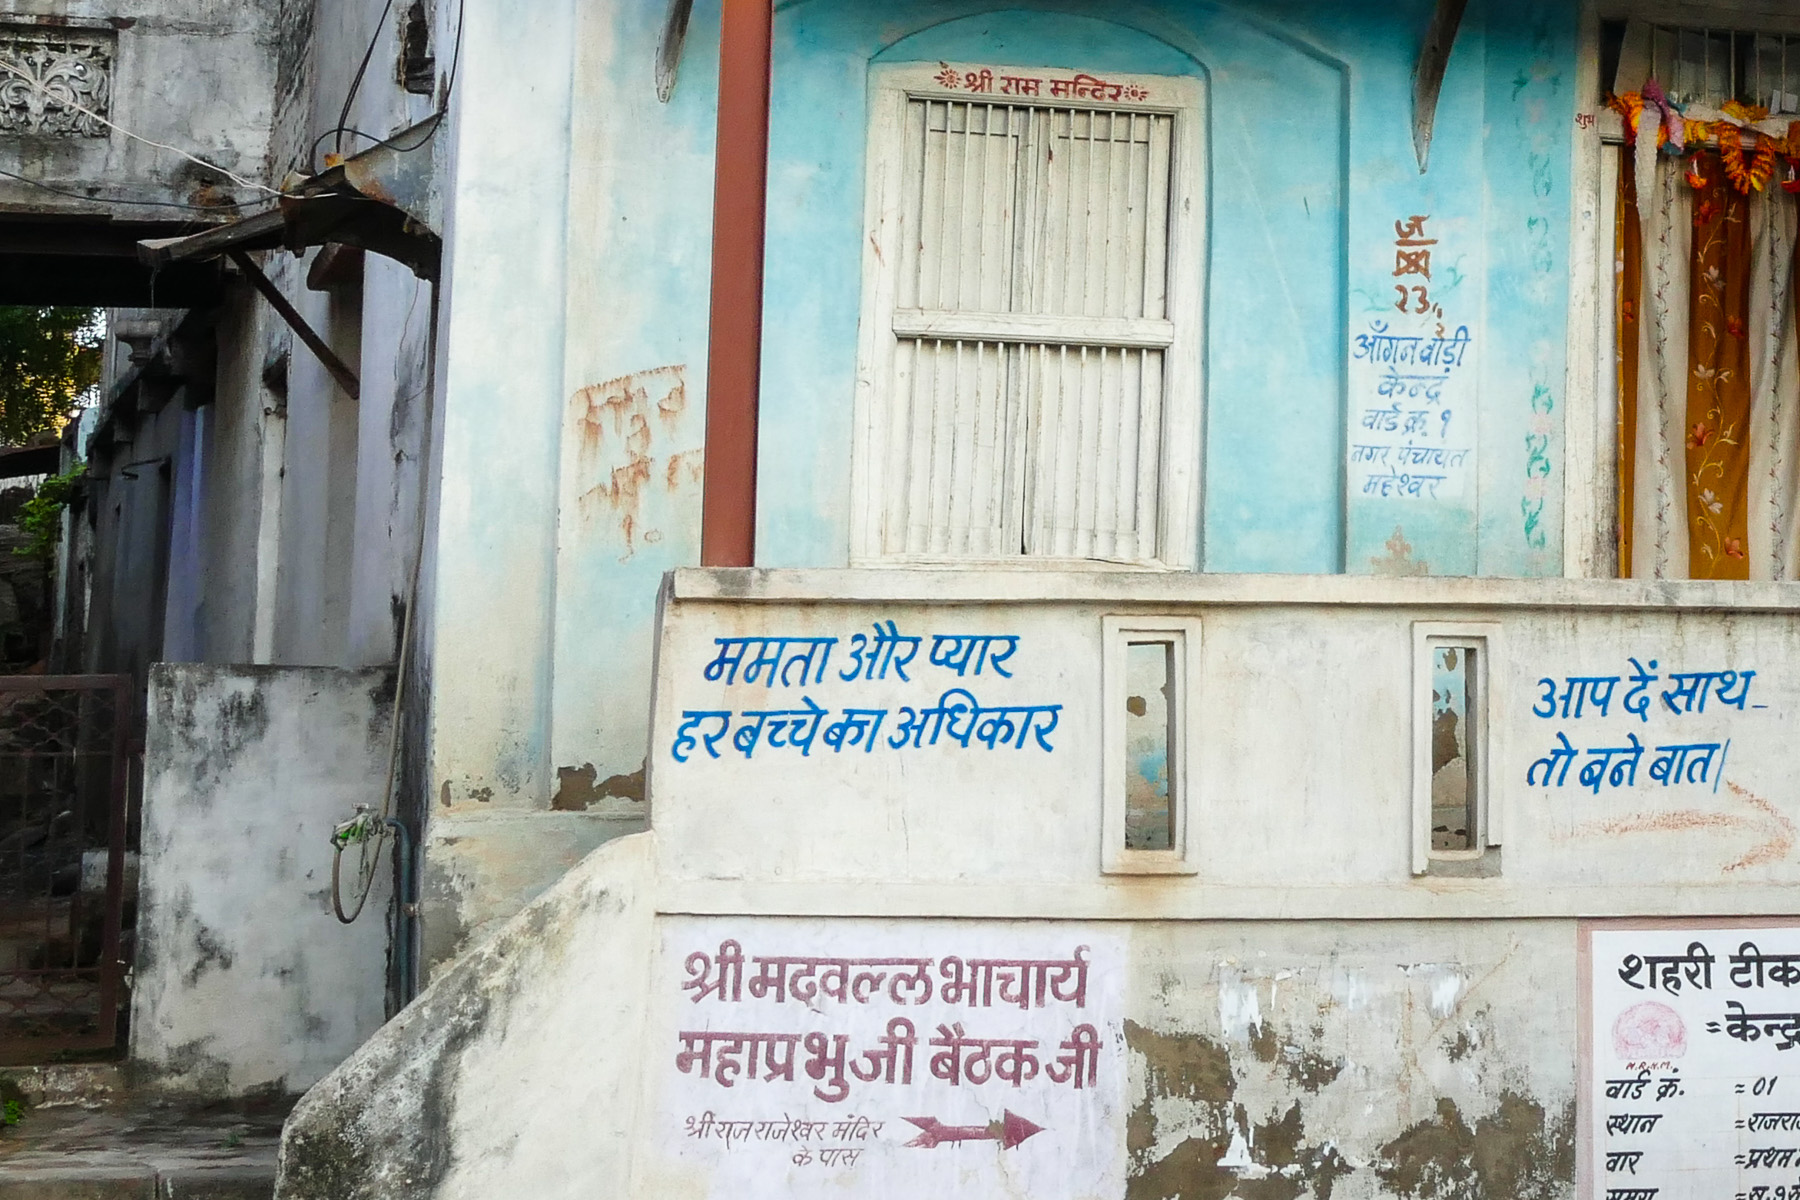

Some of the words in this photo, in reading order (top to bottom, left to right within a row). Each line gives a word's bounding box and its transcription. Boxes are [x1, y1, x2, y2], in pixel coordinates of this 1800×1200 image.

[964, 68, 993, 94] श्री
[1000, 76, 1043, 96] राम
[1050, 73, 1125, 102] मन्दिर
[1575, 113, 1595, 129] शुभ
[1377, 366, 1449, 405] केन्द्र
[1362, 401, 1403, 432] वार्ड
[1350, 444, 1391, 469] नगर
[1397, 439, 1470, 468] पंचायत
[1362, 464, 1447, 500] महेश्वर
[703, 636, 838, 688] ममता
[839, 619, 922, 683] और
[929, 634, 1021, 678] प्यार
[1532, 676, 1621, 719] आप
[1623, 657, 1660, 722] दें
[733, 695, 827, 760] बच्चे
[823, 707, 888, 754] का
[888, 688, 1064, 753] अधिकार
[1526, 731, 1578, 787] तो
[1579, 732, 1645, 794] बने
[1617, 941, 1716, 996] शहरी
[929, 1022, 1039, 1089] बैठक
[1605, 1070, 1652, 1101] वार्ड
[832, 1114, 886, 1142] मंदिर
[1606, 1113, 1663, 1135] स्थान
[792, 1146, 812, 1166] के
[819, 1148, 865, 1167] पास
[1606, 1150, 1644, 1175] वार
[1744, 1146, 1797, 1170] प्रथम
